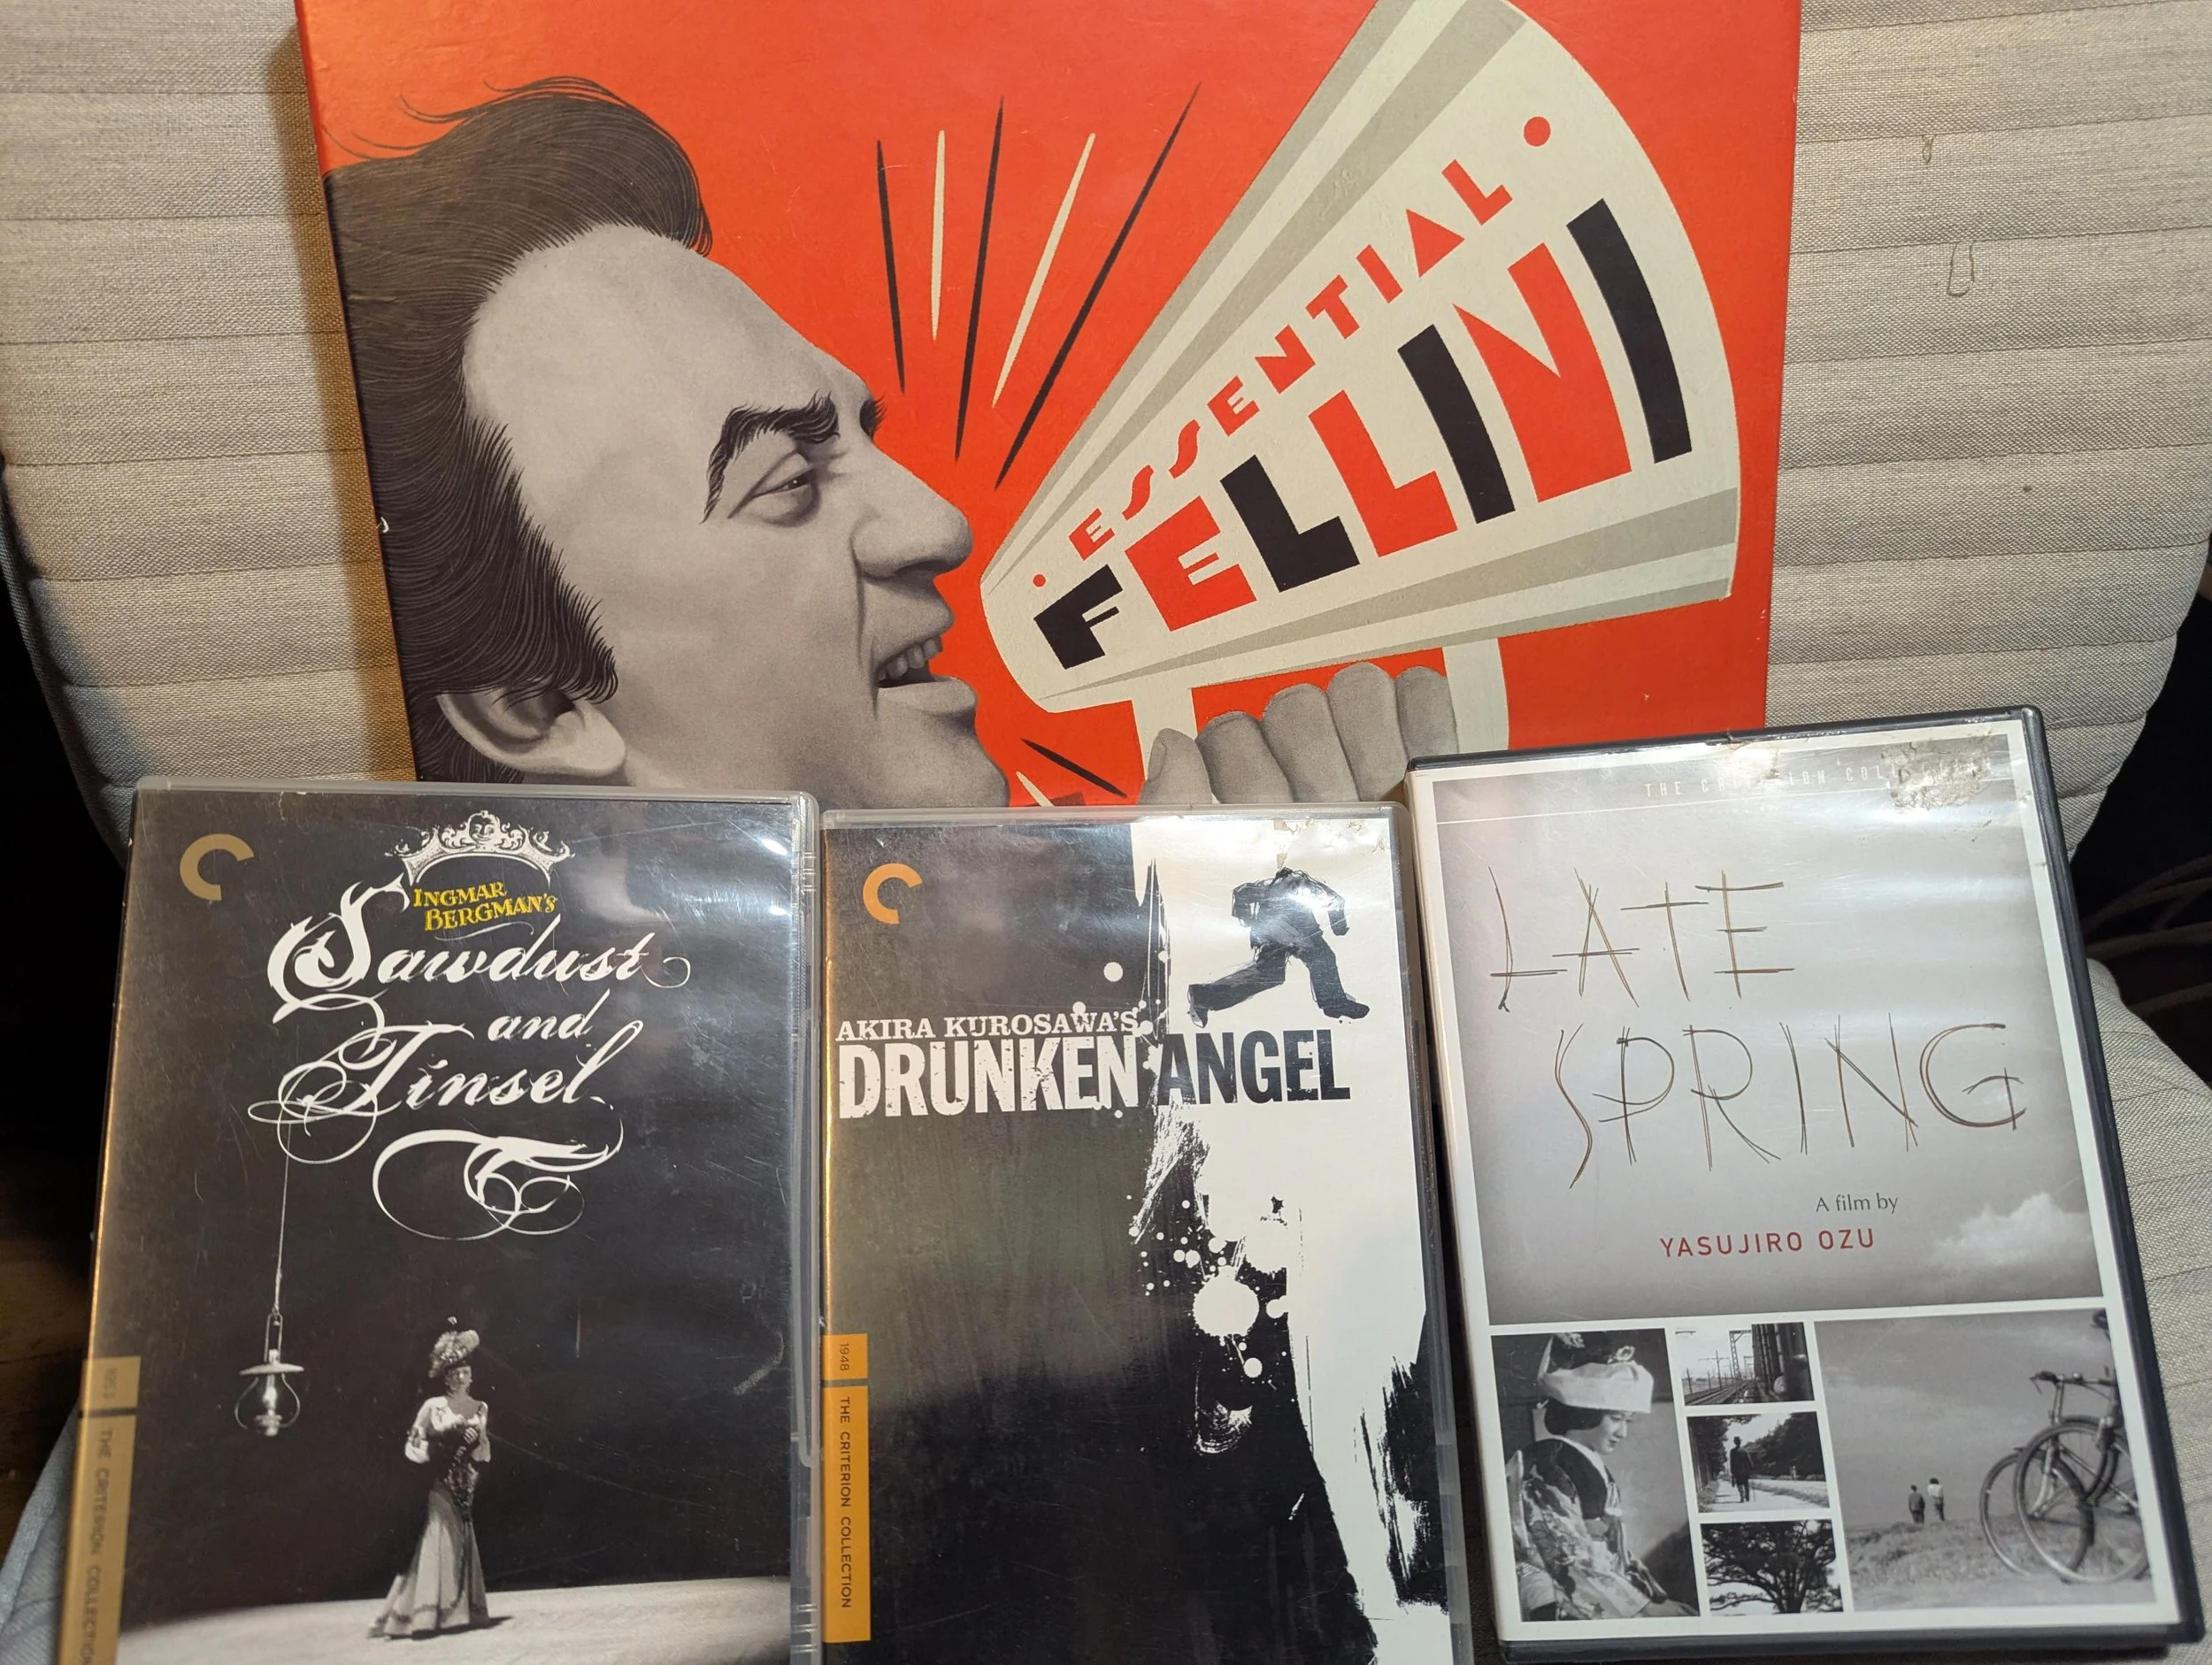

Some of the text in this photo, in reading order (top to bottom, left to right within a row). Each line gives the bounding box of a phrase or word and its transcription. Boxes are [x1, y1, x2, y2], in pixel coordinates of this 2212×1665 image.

[1069, 159, 1514, 562] ESSENTIAL
[1033, 197, 1693, 671] FELLINI
[1644, 781, 1682, 798] THE
[413, 881, 507, 908] INGMAR
[425, 893, 558, 932] BERGMAN'S
[267, 872, 690, 1021] Sawdust
[1488, 867, 1795, 1012] LATE
[486, 988, 611, 1042] and
[835, 1009, 1140, 1042] AKIRA KUROSAWA'S
[248, 1020, 644, 1128] Tinsel
[838, 1028, 1351, 1119] DRUNKEN ANGEL
[1554, 1013, 2028, 1188] SPRING
[1816, 1192, 1899, 1214] A film by
[1659, 1227, 1875, 1258] YASUJIRO OZU
[839, 1342, 850, 1372] 1948
[96, 1429, 113, 1459] THE
[89, 1468, 111, 1556] CRITERION
[840, 1395, 853, 1608] THE CRITERION COLLECTION
